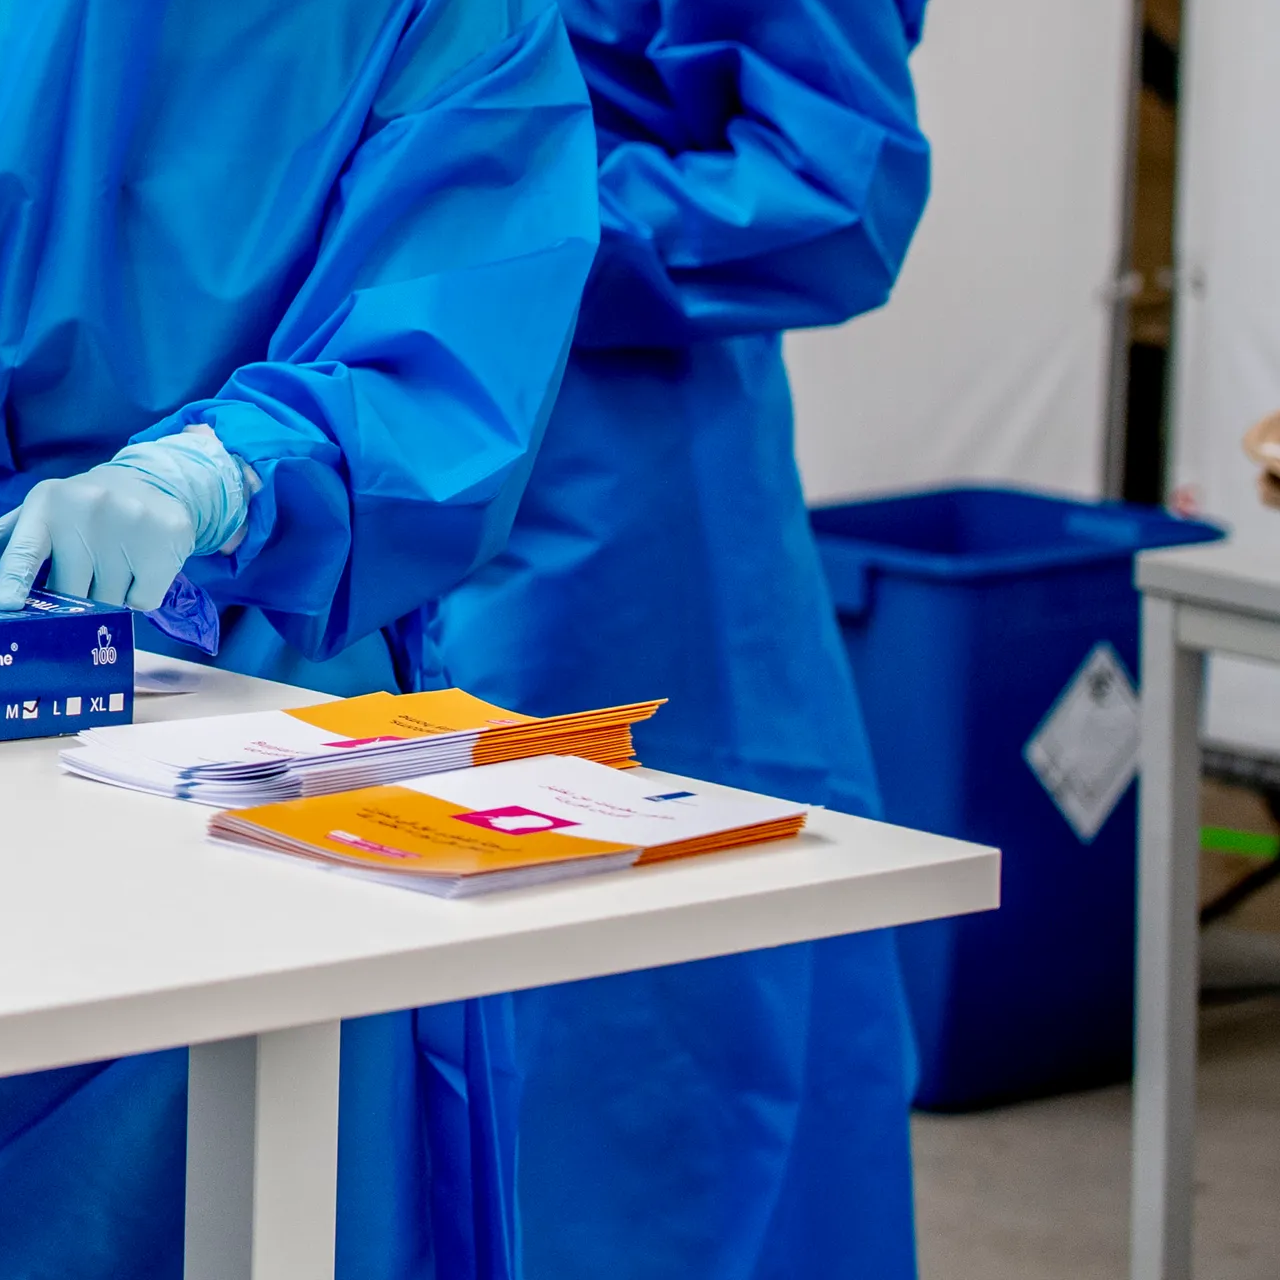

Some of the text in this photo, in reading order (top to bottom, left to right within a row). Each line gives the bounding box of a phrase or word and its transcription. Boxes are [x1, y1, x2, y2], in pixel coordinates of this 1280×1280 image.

[91, 646, 117, 666] 100
[5, 703, 19, 721] M
[53, 700, 61, 717] L
[90, 696, 107, 713] XL
